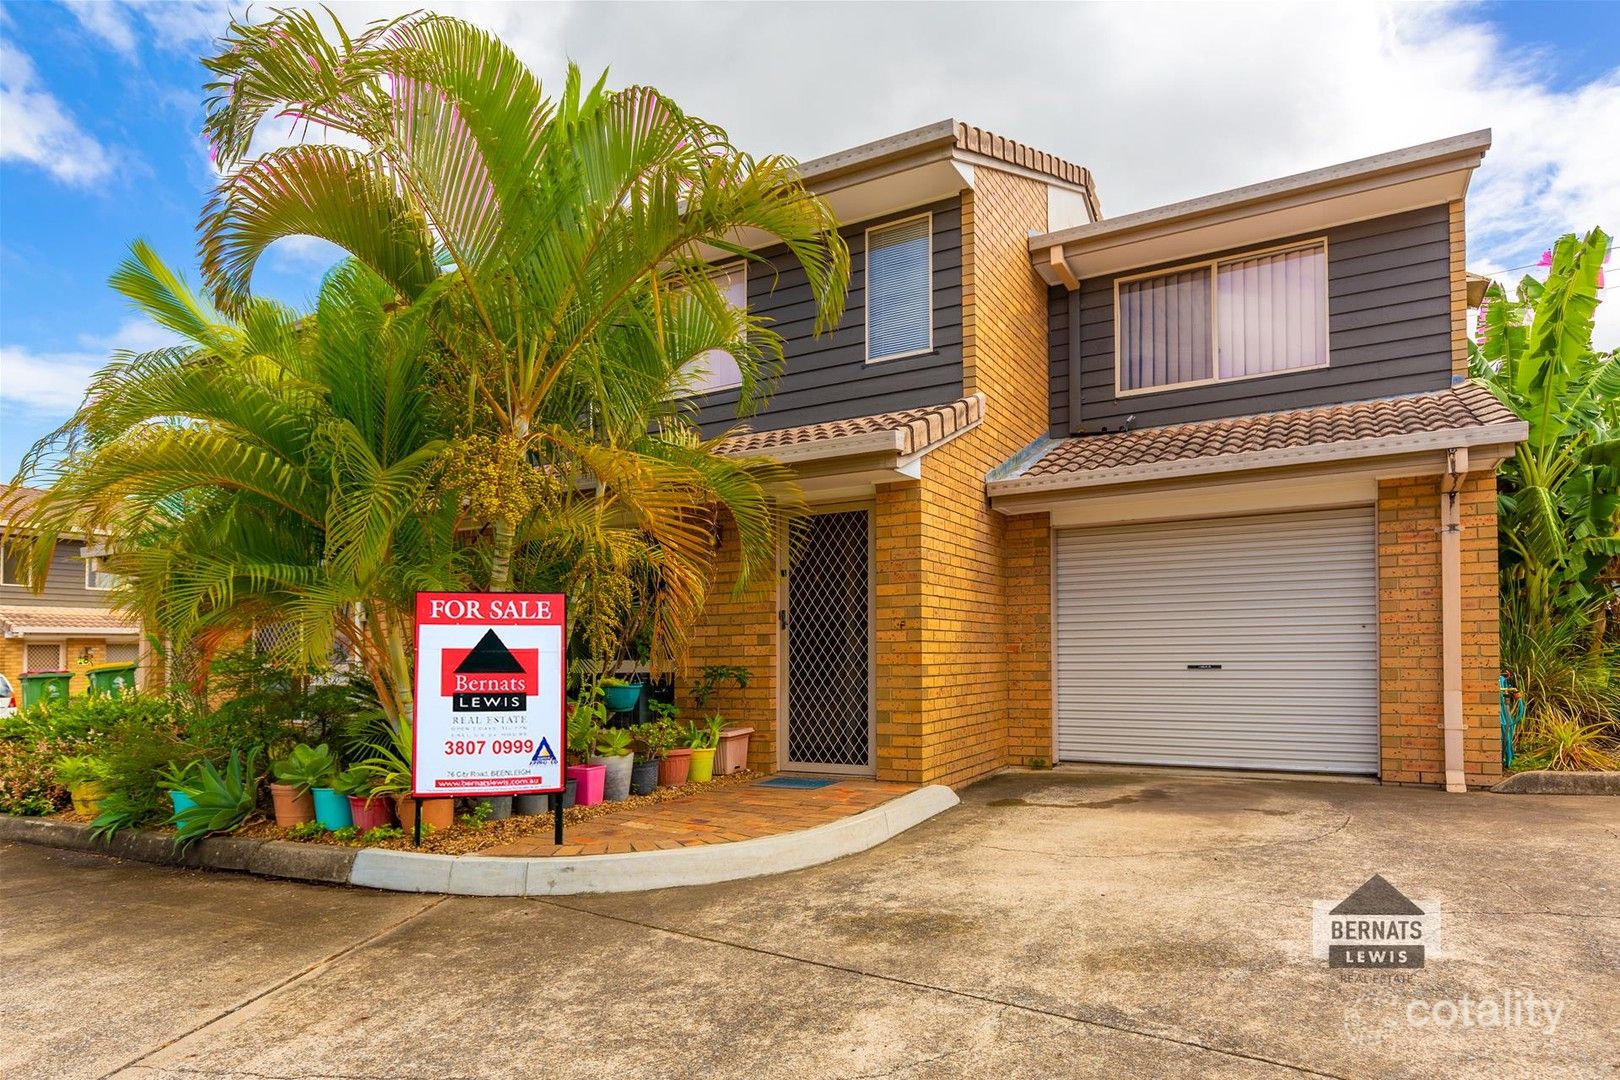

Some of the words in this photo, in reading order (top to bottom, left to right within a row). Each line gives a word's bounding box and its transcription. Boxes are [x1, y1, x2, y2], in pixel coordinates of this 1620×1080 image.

[430, 599, 484, 619] FOR
[489, 600, 551, 619] SALE
[455, 674, 526, 691] Bernats
[459, 696, 520, 708] LEWIS
[452, 716, 482, 725] REAL
[486, 715, 528, 724] ESTATE
[444, 740, 486, 755] 3807
[492, 739, 534, 754] 0999
[456, 770, 469, 778] City
[490, 768, 532, 777] BEENLEIGH
[437, 777, 539, 787] www.bernatslewis.com.au
